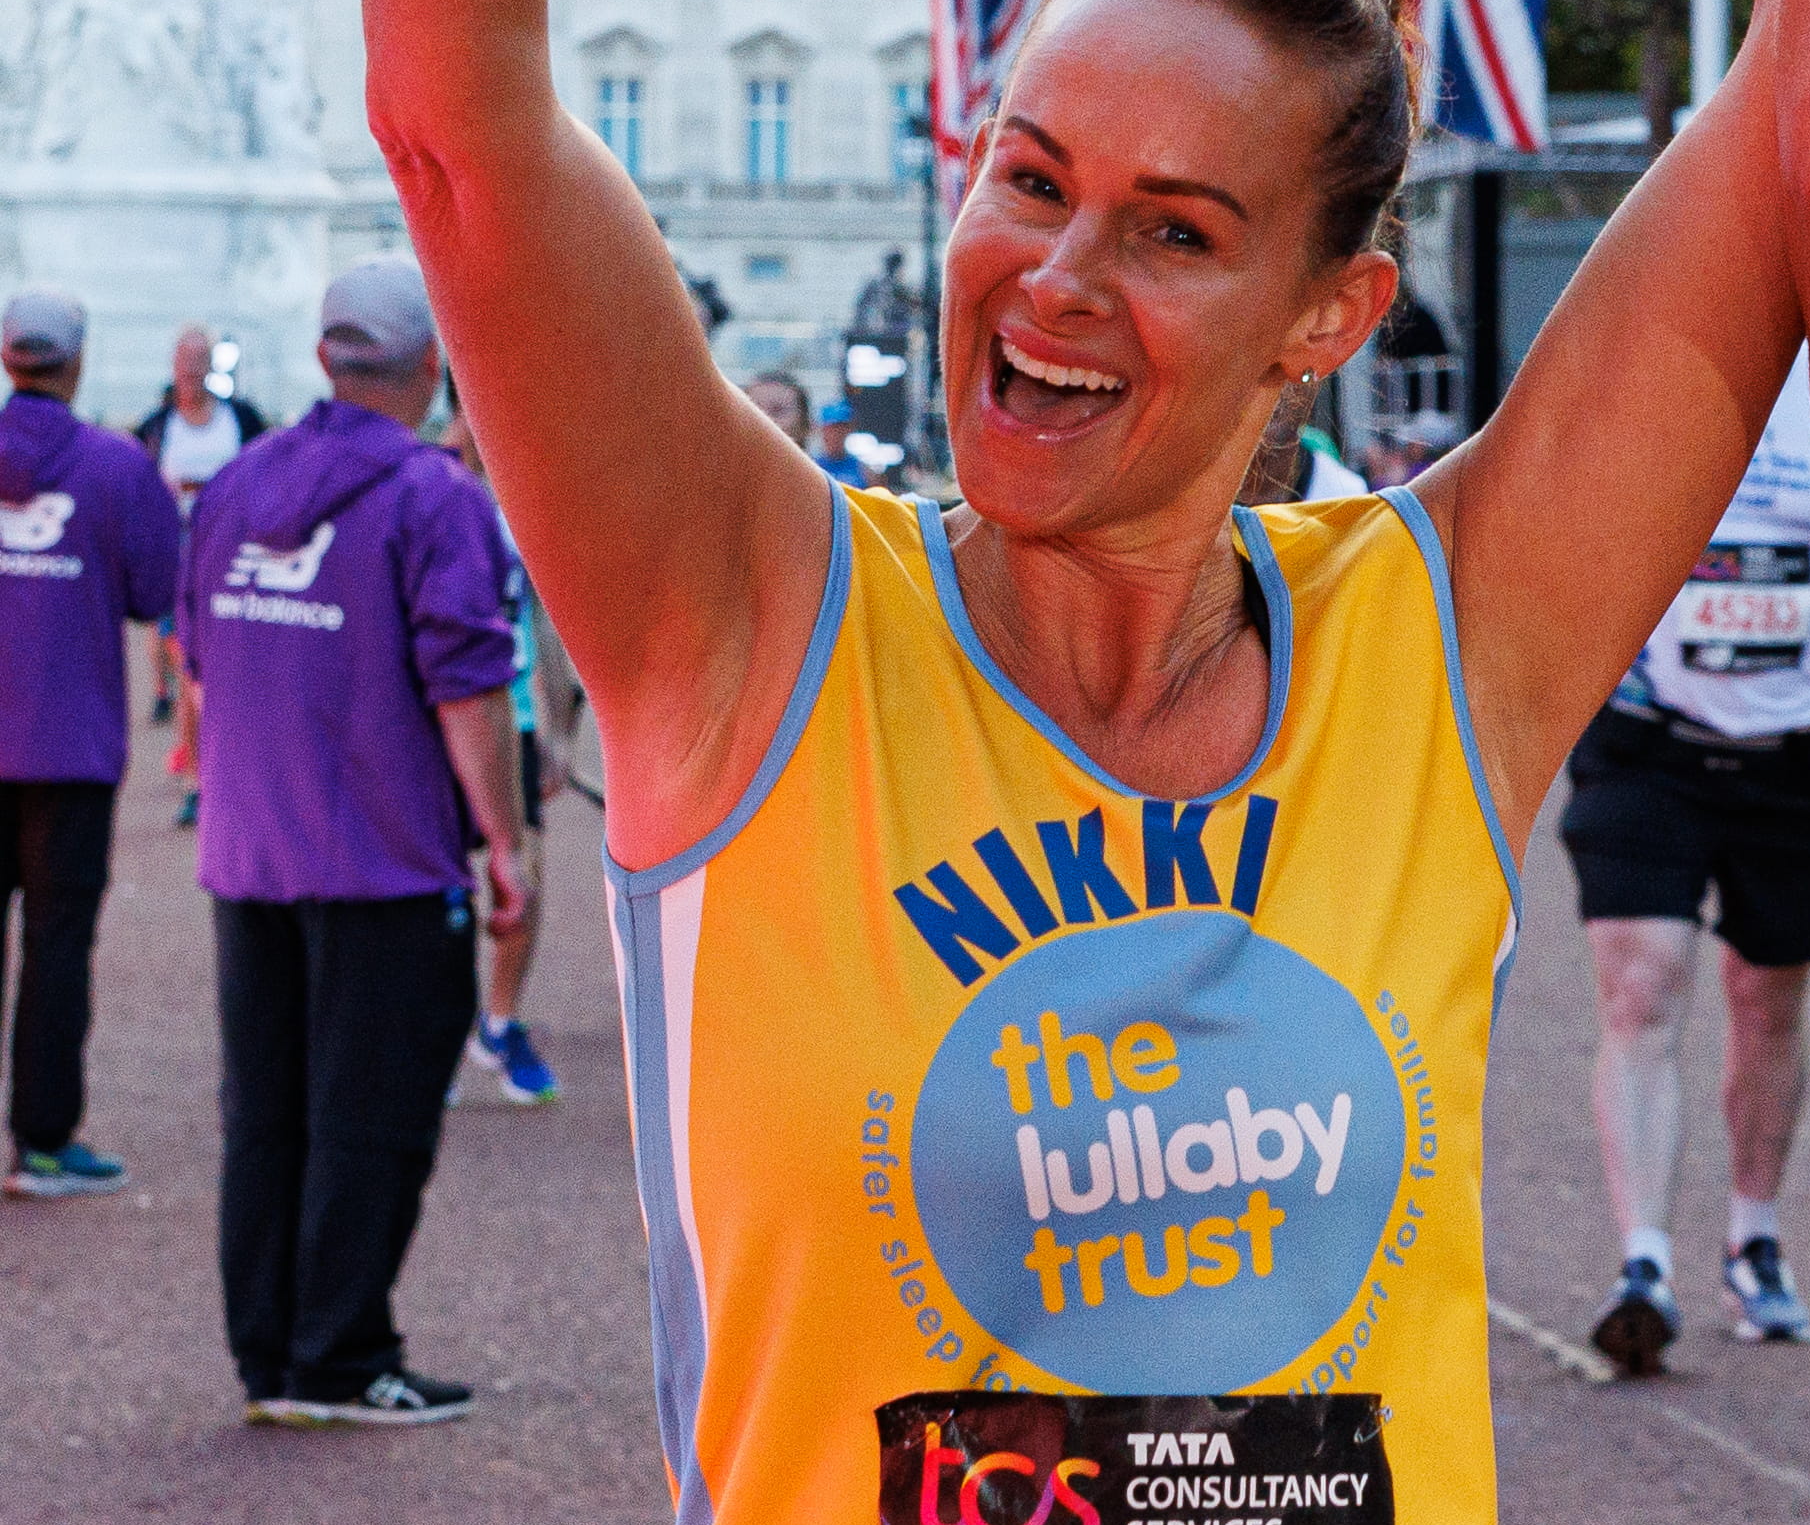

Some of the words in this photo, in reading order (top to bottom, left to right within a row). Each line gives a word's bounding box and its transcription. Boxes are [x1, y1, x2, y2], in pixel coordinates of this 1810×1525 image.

[894, 795, 1278, 987] NIKKI
[991, 1011, 1181, 1114] the
[1375, 989, 1438, 1181] families
[861, 1089, 900, 1219] safer
[1016, 1086, 1352, 1221] lullaby
[1023, 1189, 1285, 1314] trust
[1383, 1198, 1426, 1267] for
[880, 1238, 964, 1362] sleep
[969, 1353, 1033, 1393] fo
[1126, 1474, 1367, 1510] CONSULTANCY
[1128, 1432, 1234, 1465] TATA
